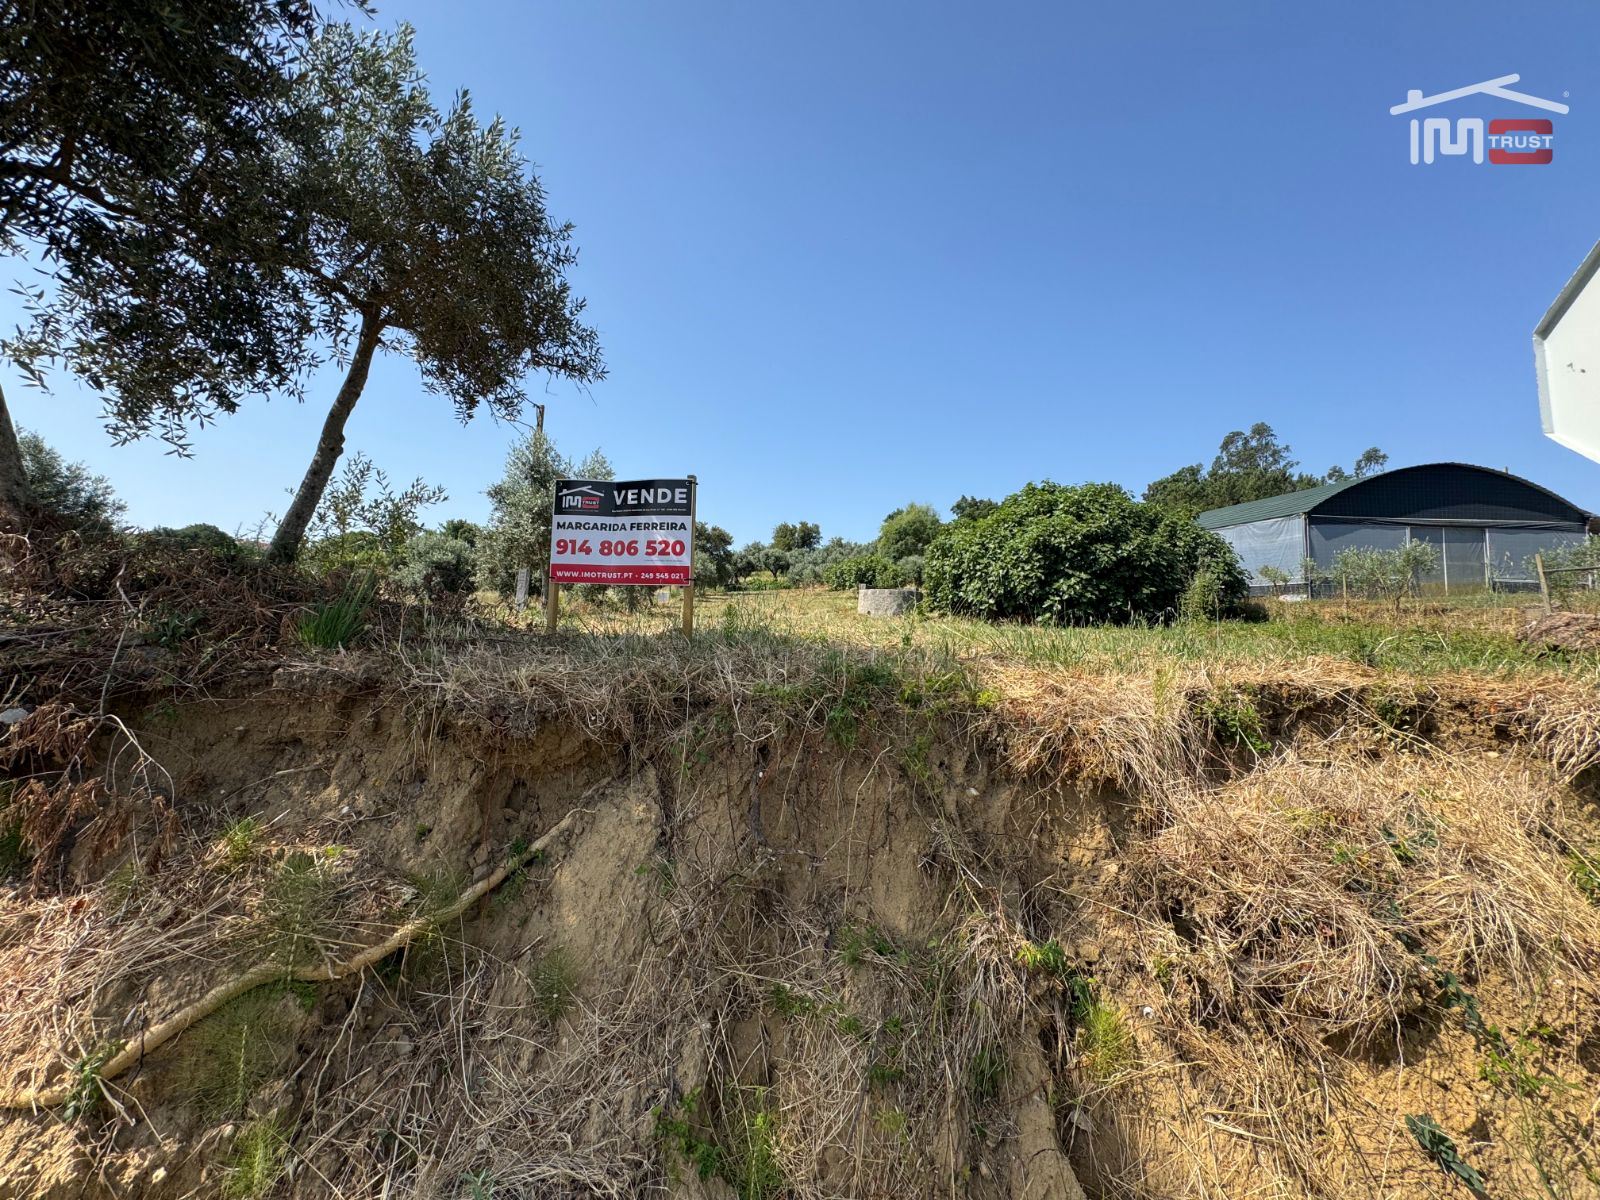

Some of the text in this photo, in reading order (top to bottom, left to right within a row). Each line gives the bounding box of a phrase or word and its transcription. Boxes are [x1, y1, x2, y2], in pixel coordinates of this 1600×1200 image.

[613, 488, 688, 506] VENDE
[556, 521, 687, 532] MARGARIDA FERREIRA
[555, 539, 686, 557] 914 806 520
[556, 570, 633, 579] WWW.IMOTRUST.PT
[655, 572, 669, 580] 545
